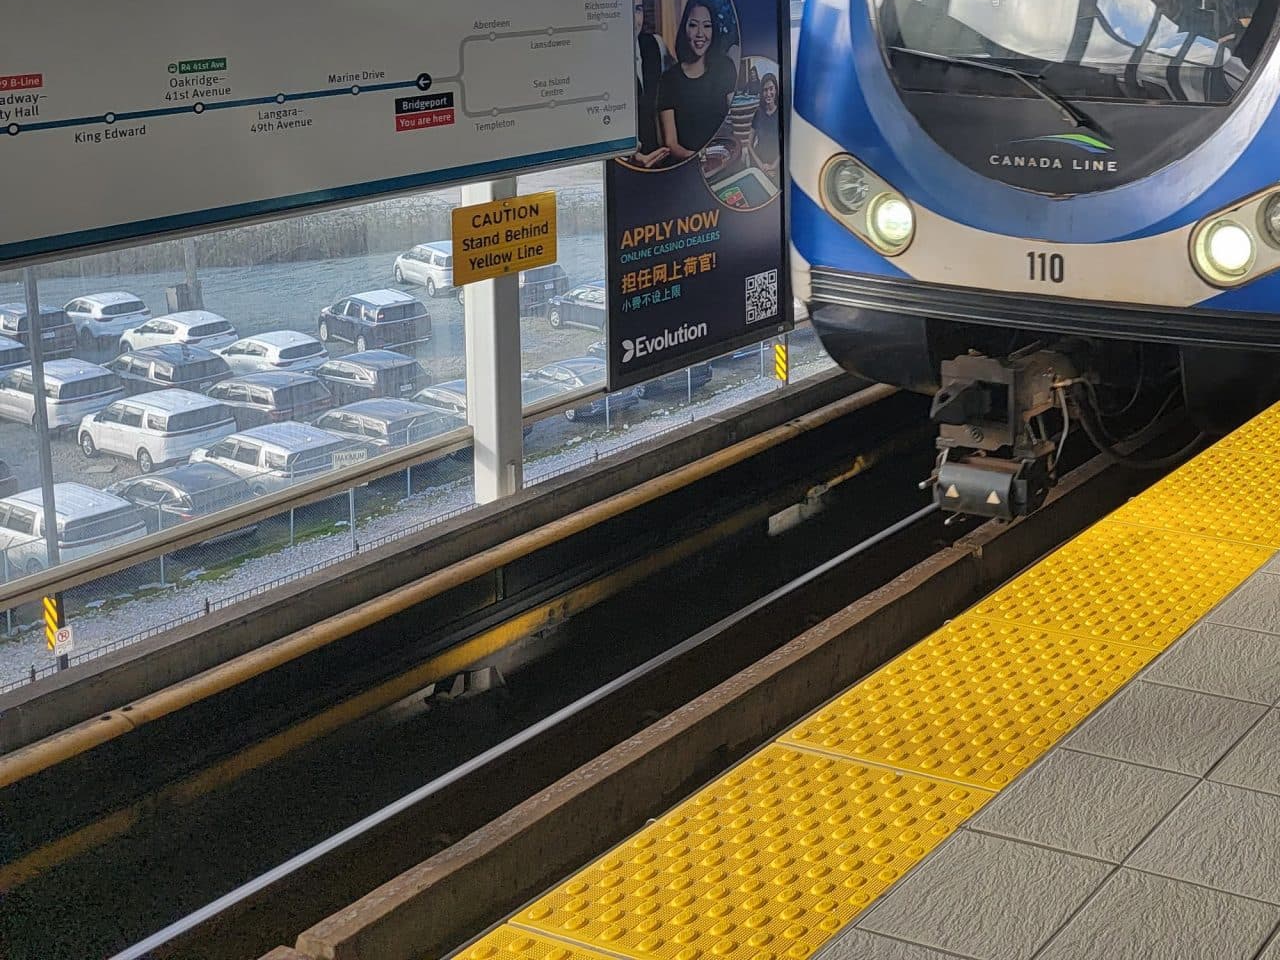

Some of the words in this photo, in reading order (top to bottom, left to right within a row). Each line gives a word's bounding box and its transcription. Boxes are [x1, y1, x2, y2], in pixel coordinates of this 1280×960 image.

[473, 19, 510, 30] Aberdeen
[211, 60, 224, 69] Ave
[11, 77, 40, 87] B-Line
[328, 72, 360, 84] Marine
[363, 70, 385, 81] Drive
[533, 79, 546, 88] Sea
[165, 90, 189, 101] 41st
[192, 86, 231, 98] Avenue
[15, 105, 39, 117] Hall
[402, 96, 447, 111] Bridgeport
[251, 121, 274, 133] 49th
[277, 118, 312, 130] Avenue
[400, 118, 415, 127] You
[418, 116, 431, 125] are
[433, 114, 451, 124] here
[475, 119, 515, 132] Templeton
[75, 130, 101, 144] King
[105, 125, 146, 139] Edward
[989, 155, 1063, 169] CANADA
[1072, 159, 1118, 172] LINE
[472, 203, 539, 228] CAUTION
[462, 232, 500, 251] Stand
[505, 221, 549, 242] Behind
[621, 219, 674, 250] APPLY
[677, 209, 720, 235] NOW
[620, 247, 652, 264] ONLINE
[653, 239, 685, 256] CASINO
[686, 230, 721, 247] DEALERS
[469, 251, 513, 271] Yellow
[517, 244, 544, 260] Line
[1027, 251, 1064, 283] 110
[635, 322, 708, 358] Evolution
